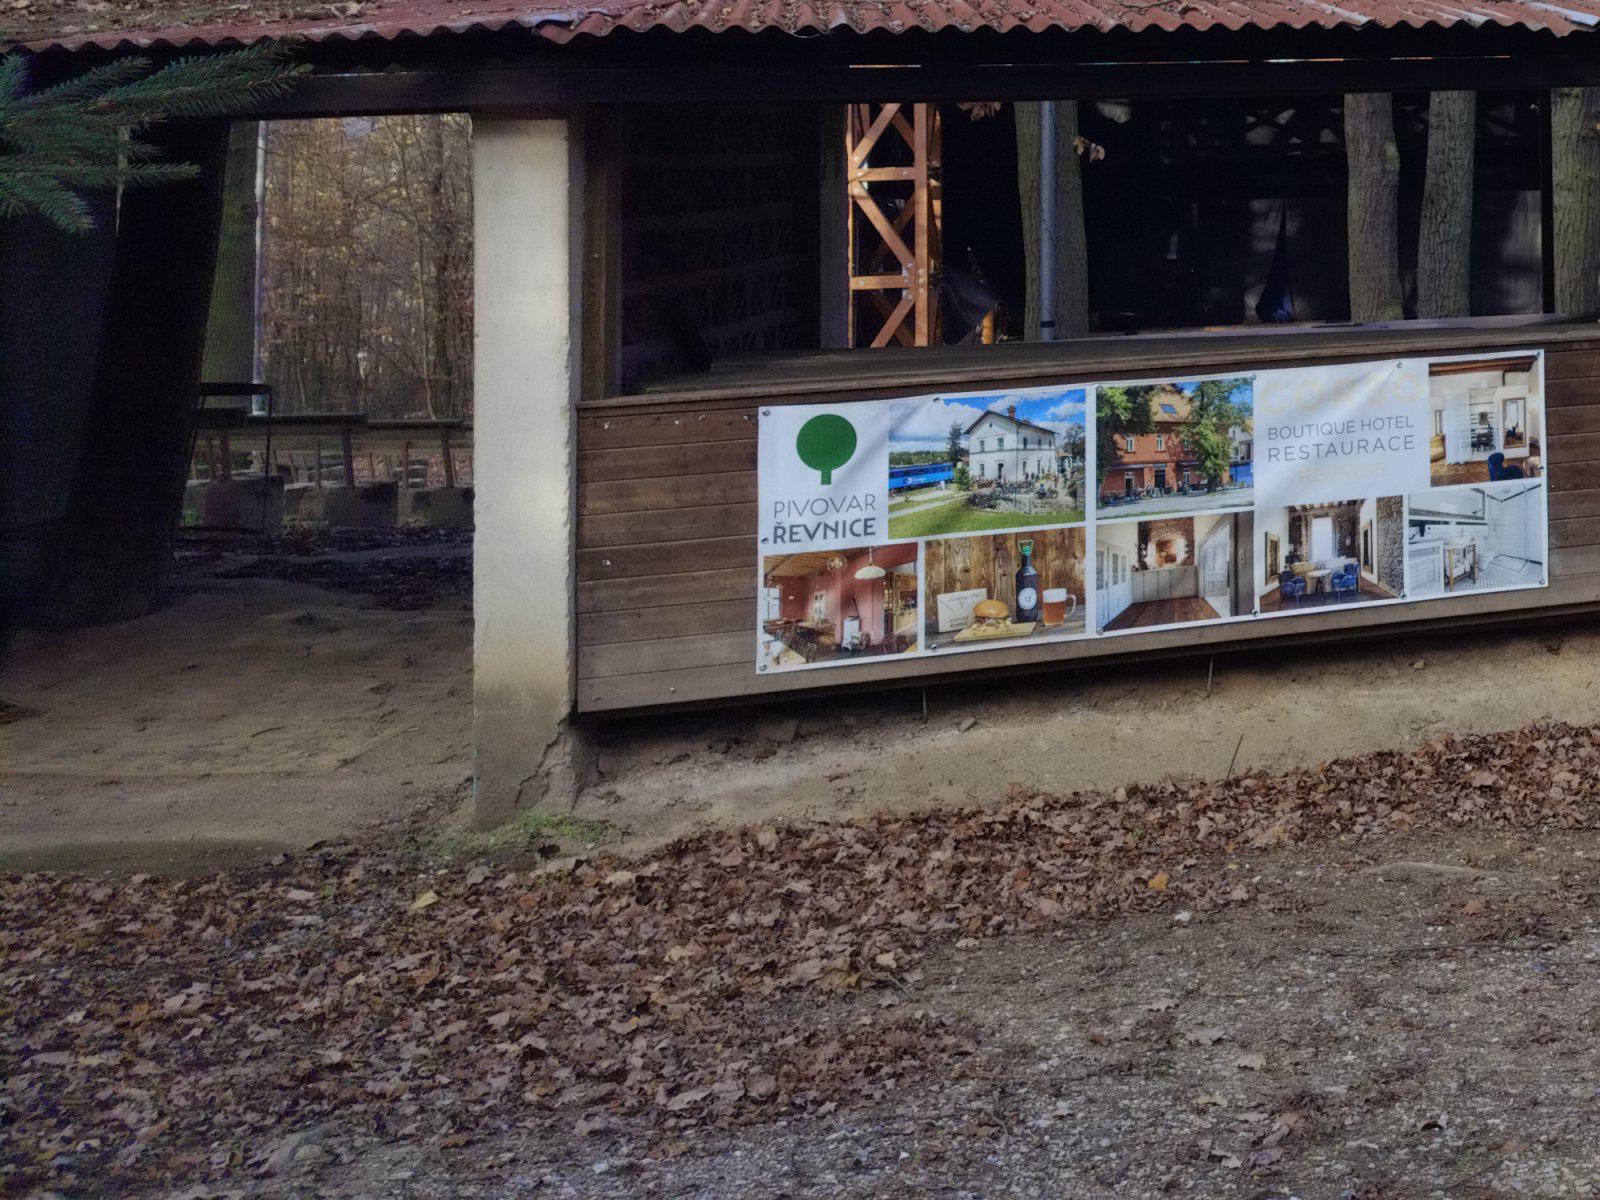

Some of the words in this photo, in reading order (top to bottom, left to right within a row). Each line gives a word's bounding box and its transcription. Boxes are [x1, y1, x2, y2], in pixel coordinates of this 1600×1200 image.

[1268, 420, 1357, 441] BOUTIQUE
[1361, 415, 1415, 432] HOTEL
[1268, 434, 1415, 463] RESTAURACE
[774, 493, 876, 519] PIVOVAR
[773, 517, 876, 544] ŘEVNICE
